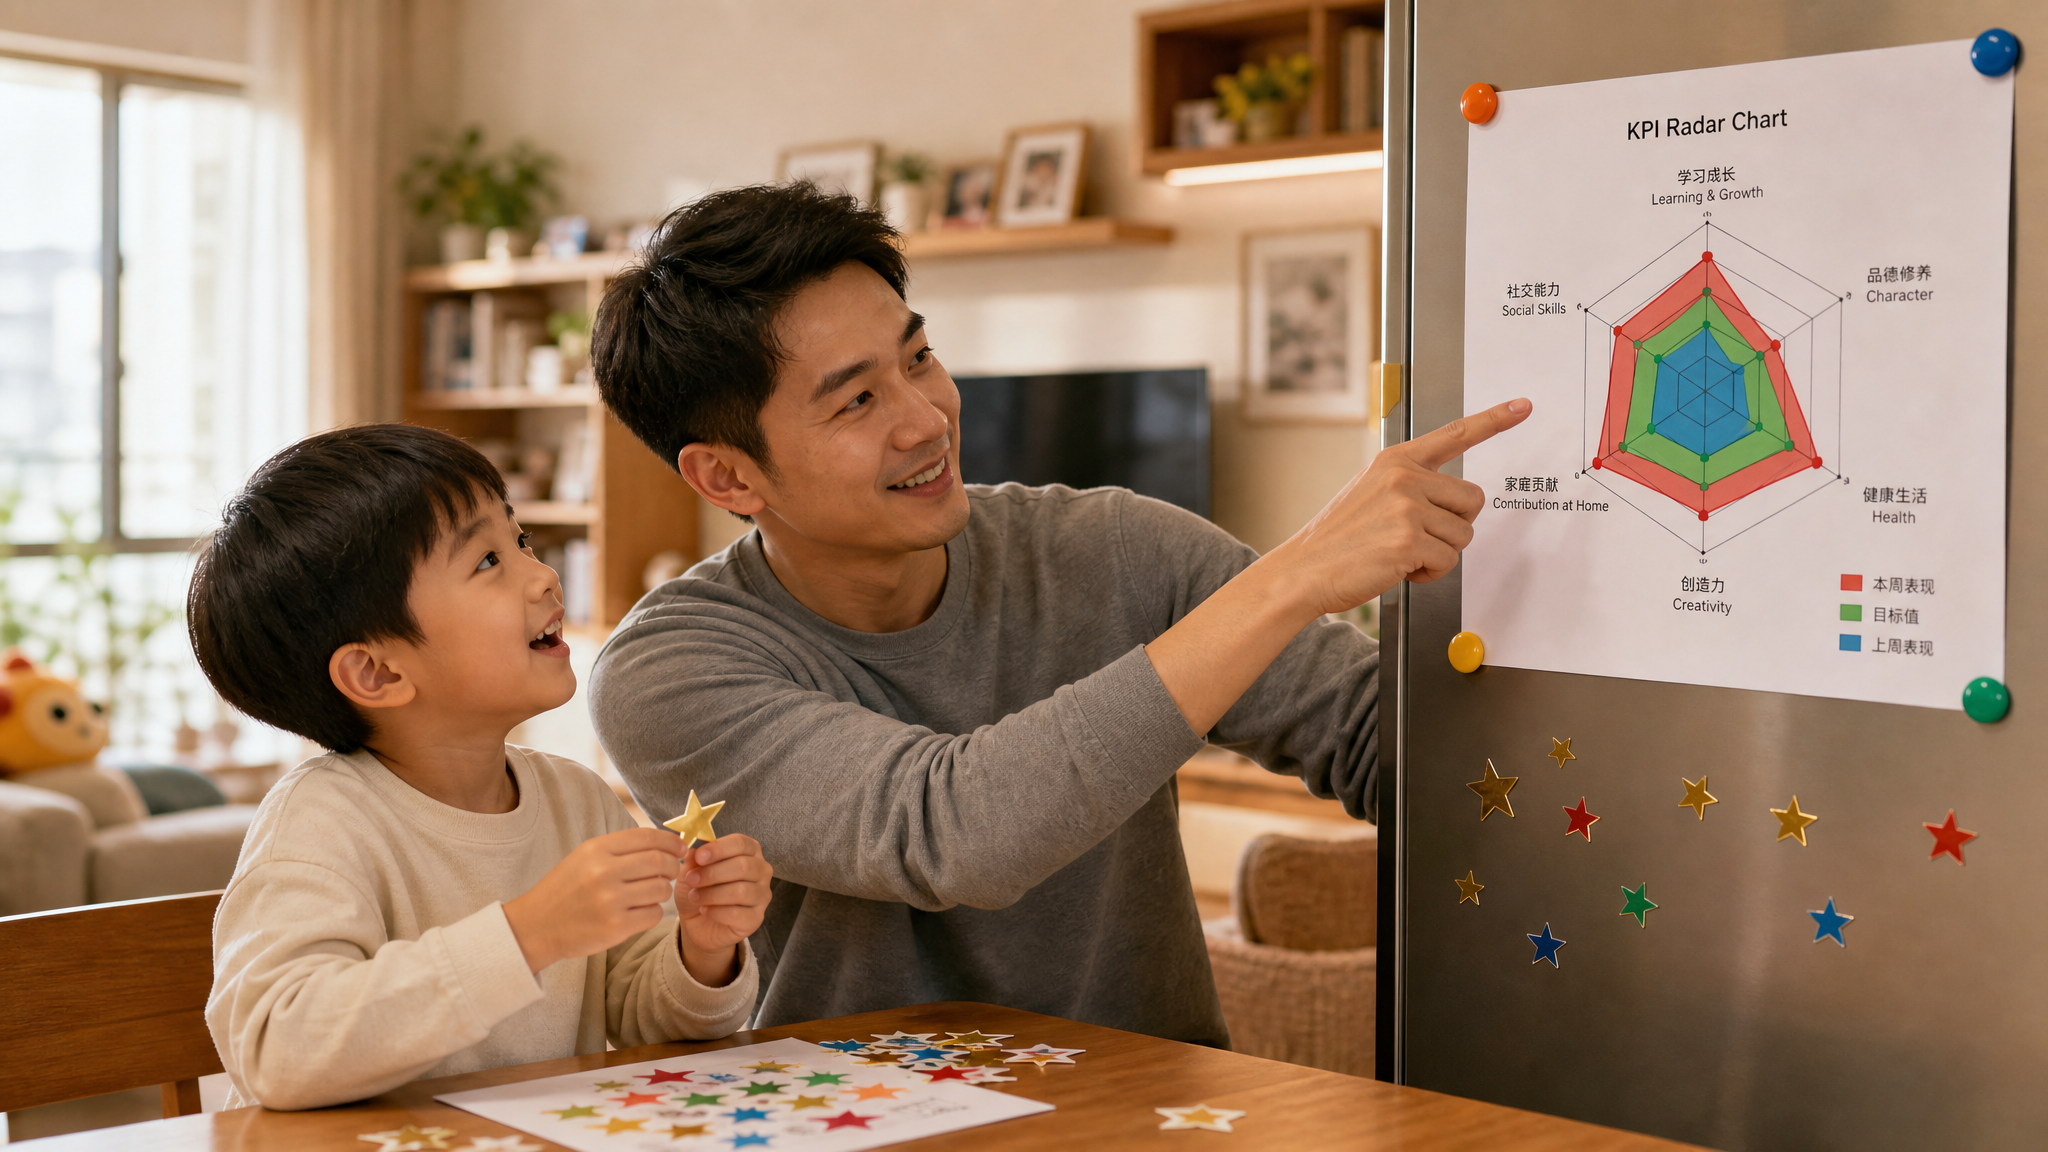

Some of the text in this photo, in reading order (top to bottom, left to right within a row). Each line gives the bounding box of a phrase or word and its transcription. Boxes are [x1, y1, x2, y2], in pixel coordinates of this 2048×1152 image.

[1627, 108, 1788, 140] KPI Radar Chart
[1677, 166, 1736, 186] 学习成长
[1651, 186, 1764, 206] Learning & Growth
[1867, 264, 1932, 284] 品德修养
[1506, 281, 1560, 300] 社交能力
[1866, 288, 1934, 304] Character
[1502, 304, 1535, 317] Social
[1537, 302, 1567, 316] Skills
[1504, 475, 1559, 493] 家庭贡献
[1492, 497, 1609, 512] Contribution at Home
[1862, 486, 1928, 505] 健康生活
[1872, 510, 1916, 524] Health
[1680, 575, 1725, 594] 创造力
[1872, 576, 1935, 596] 本周表现
[1672, 597, 1733, 617] Creativity
[1873, 606, 1920, 625] 目标值
[1871, 636, 1934, 657] 上周表现
